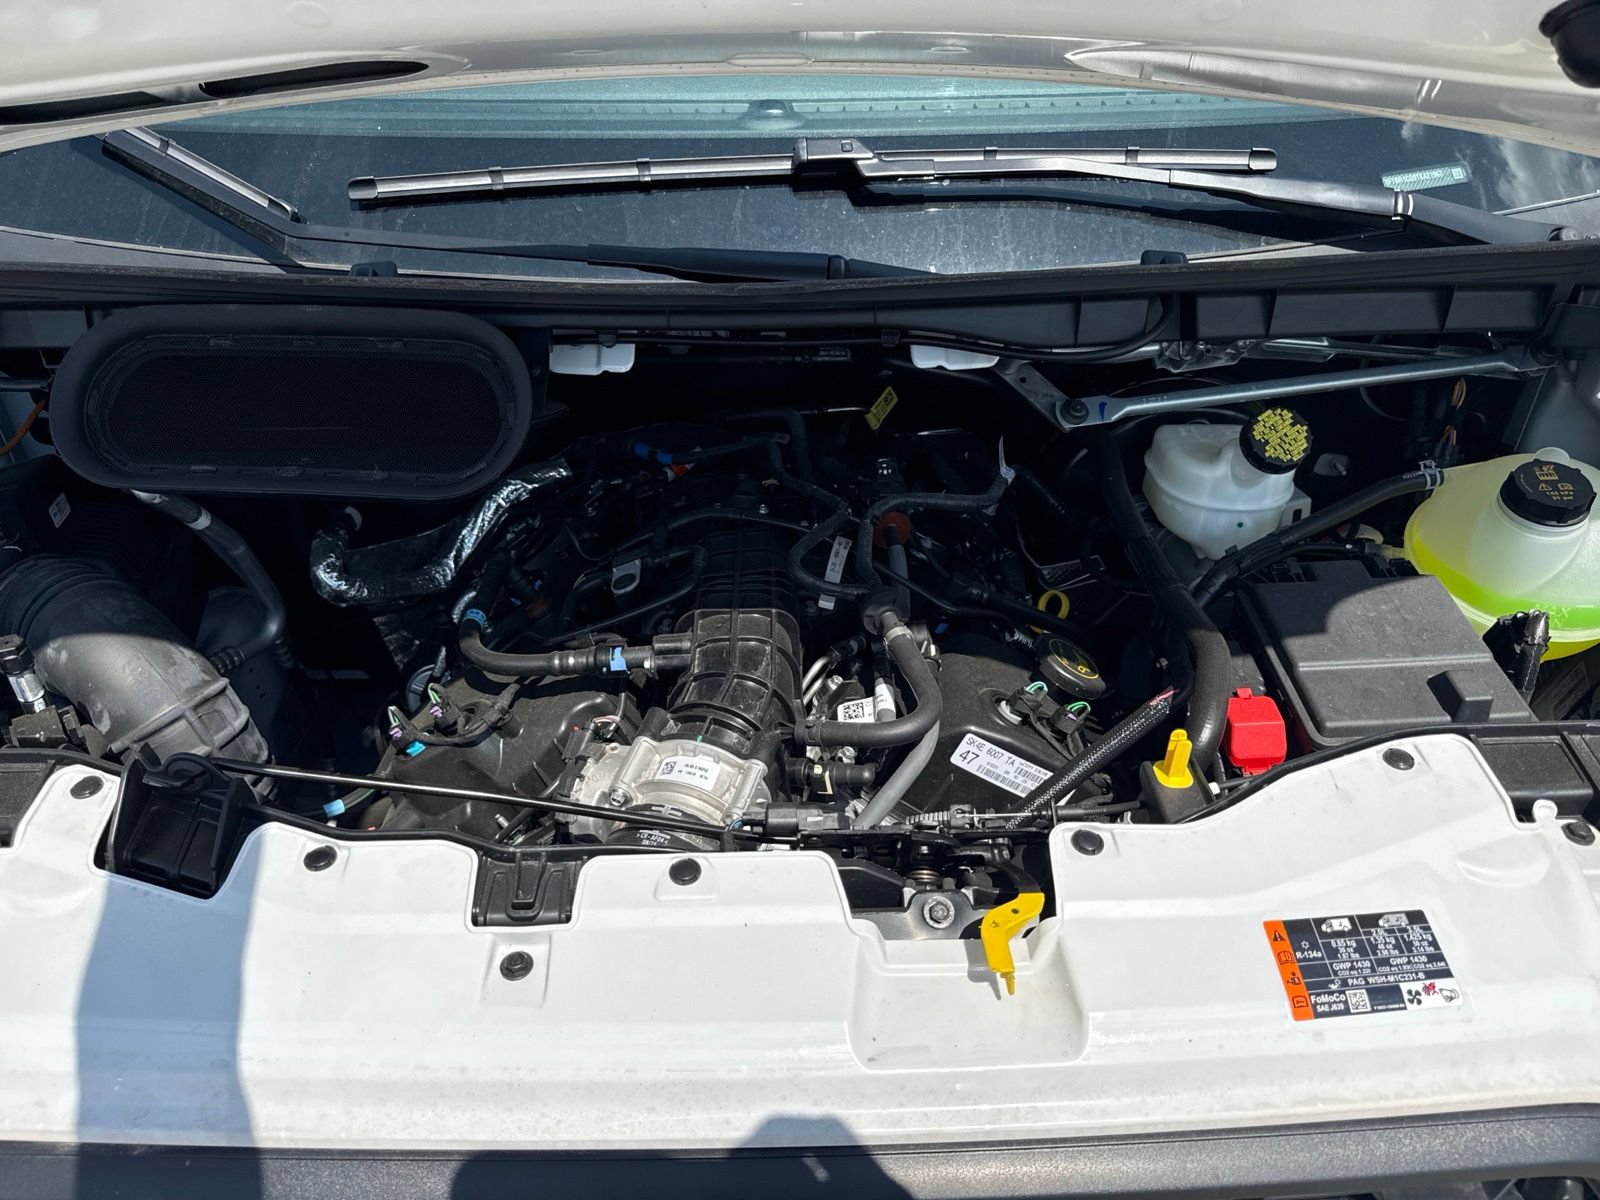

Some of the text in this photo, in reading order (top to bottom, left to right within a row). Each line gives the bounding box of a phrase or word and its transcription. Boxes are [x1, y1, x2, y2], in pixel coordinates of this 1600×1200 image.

[959, 750, 979, 765] 47
[986, 747, 1004, 760] 6007
[1004, 755, 1016, 767] TA
[1385, 936, 1396, 945] kg
[1422, 932, 1433, 941] kg
[1346, 939, 1357, 948] kg
[1295, 950, 1323, 960] R-134a
[1390, 955, 1428, 965] GWP 1430
[1332, 960, 1371, 970] GWP 1430
[1347, 972, 1426, 986] PAG WSH-M1C231-B
[1310, 993, 1346, 1004] FoMoCo
[1316, 1002, 1345, 1012] SAE J639
